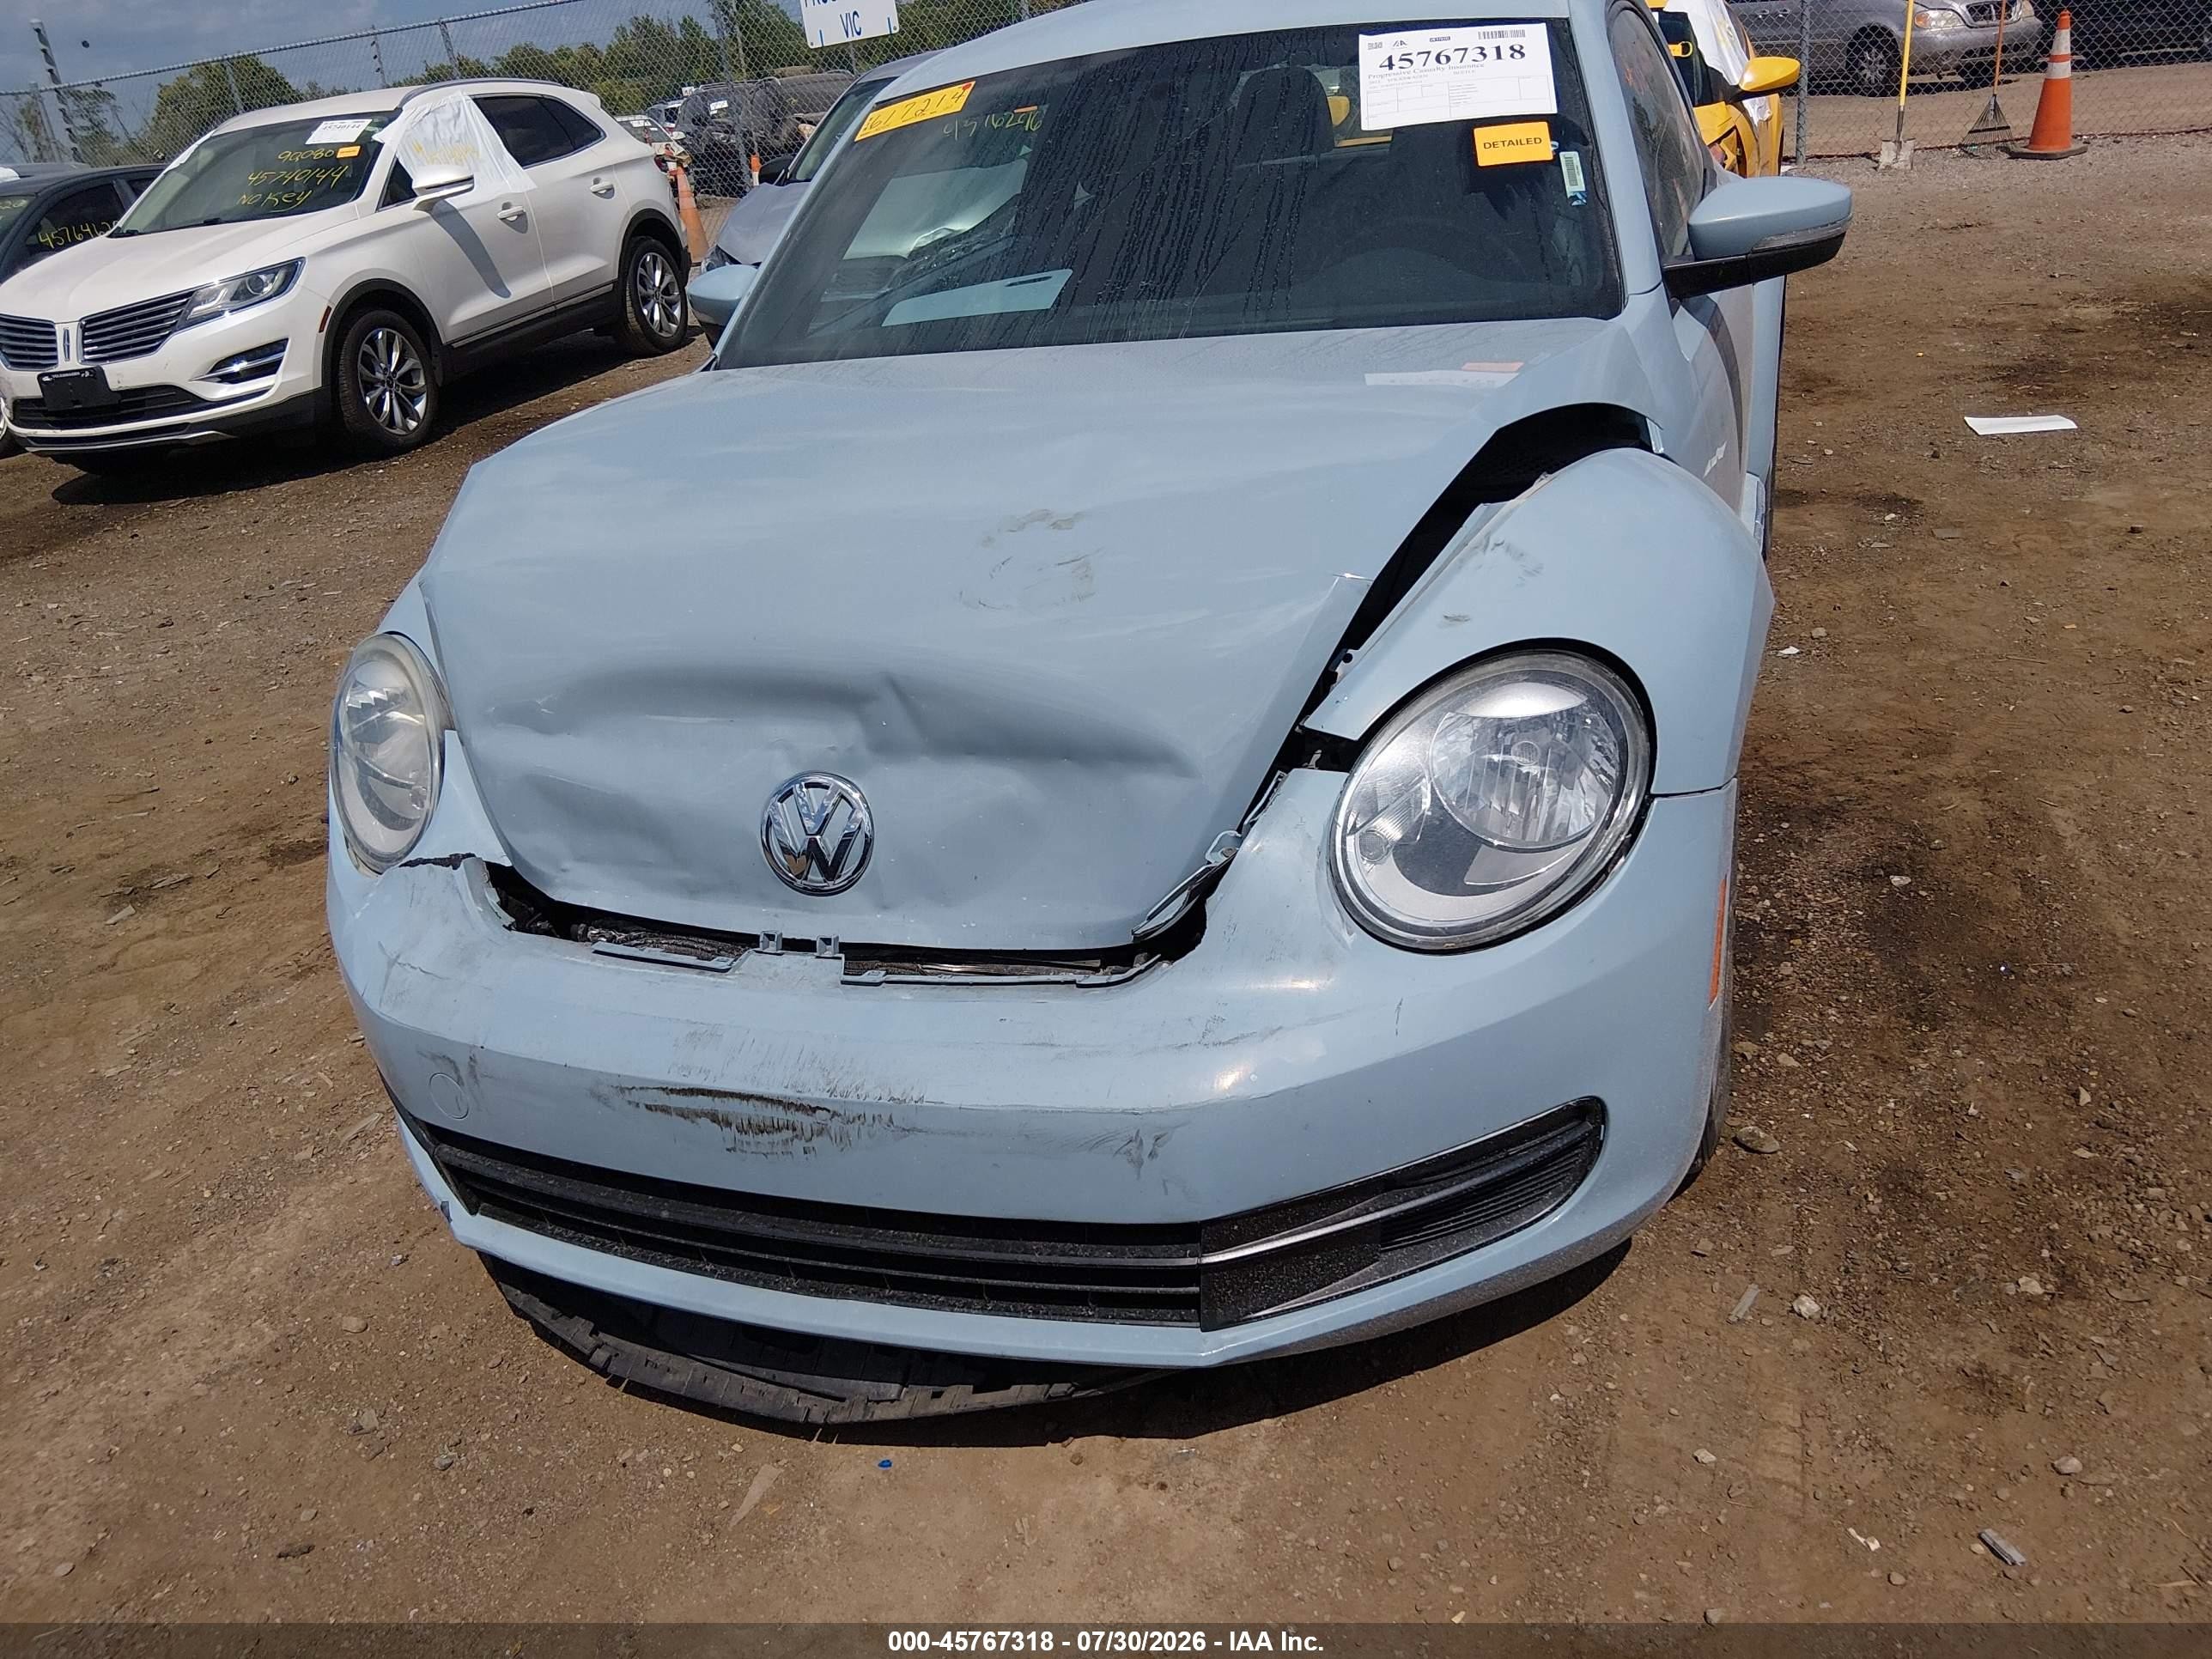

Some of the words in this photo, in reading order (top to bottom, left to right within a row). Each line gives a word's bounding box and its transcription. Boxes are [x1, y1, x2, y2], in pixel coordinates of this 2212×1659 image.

[840, 10, 862, 39] VIC
[1379, 44, 1526, 70] 45767318
[1483, 137, 1542, 149] DETAILED
[248, 166, 349, 189] 45740144
[763, 774, 872, 895] VW
